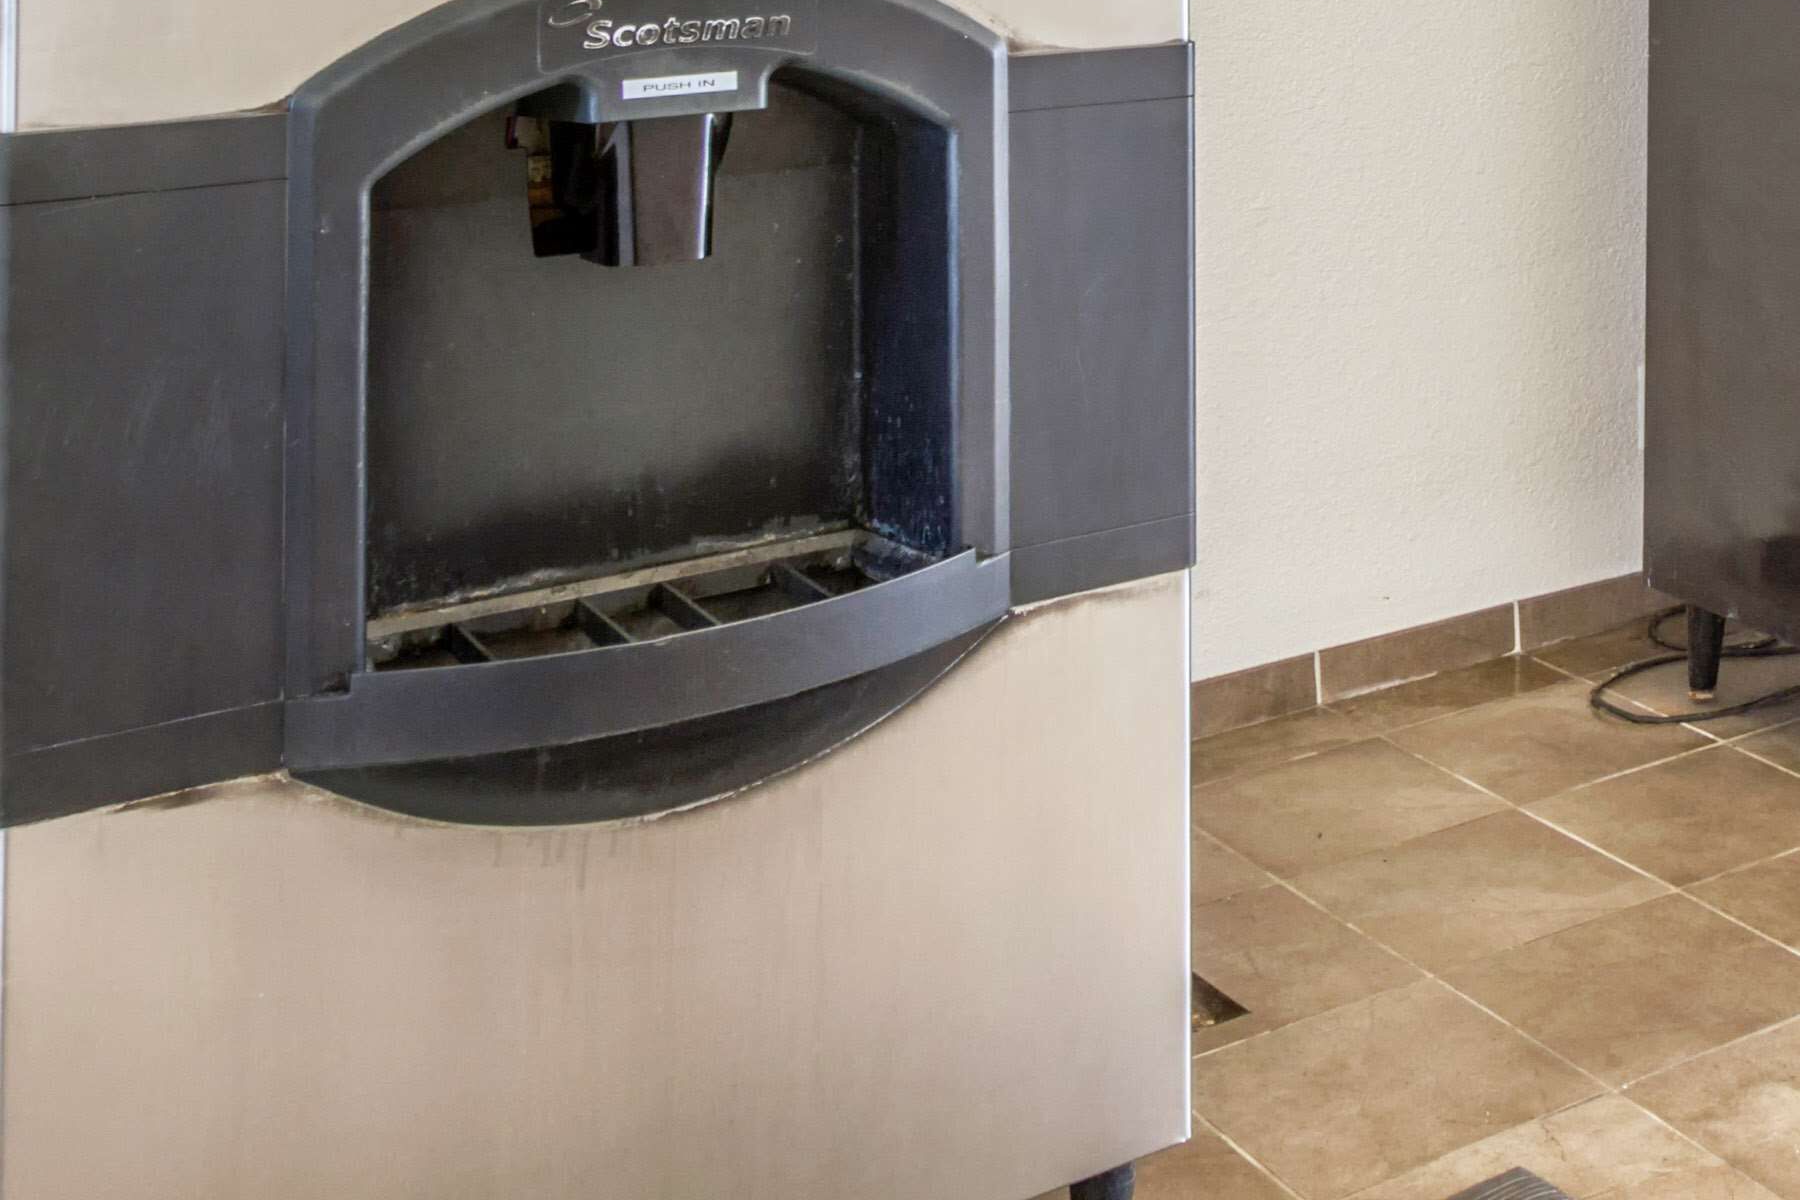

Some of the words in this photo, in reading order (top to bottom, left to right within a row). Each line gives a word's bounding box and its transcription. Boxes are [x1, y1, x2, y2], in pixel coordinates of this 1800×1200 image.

[582, 13, 792, 50] Scotsman
[642, 80, 692, 93] PUSH
[698, 78, 716, 89] IN
